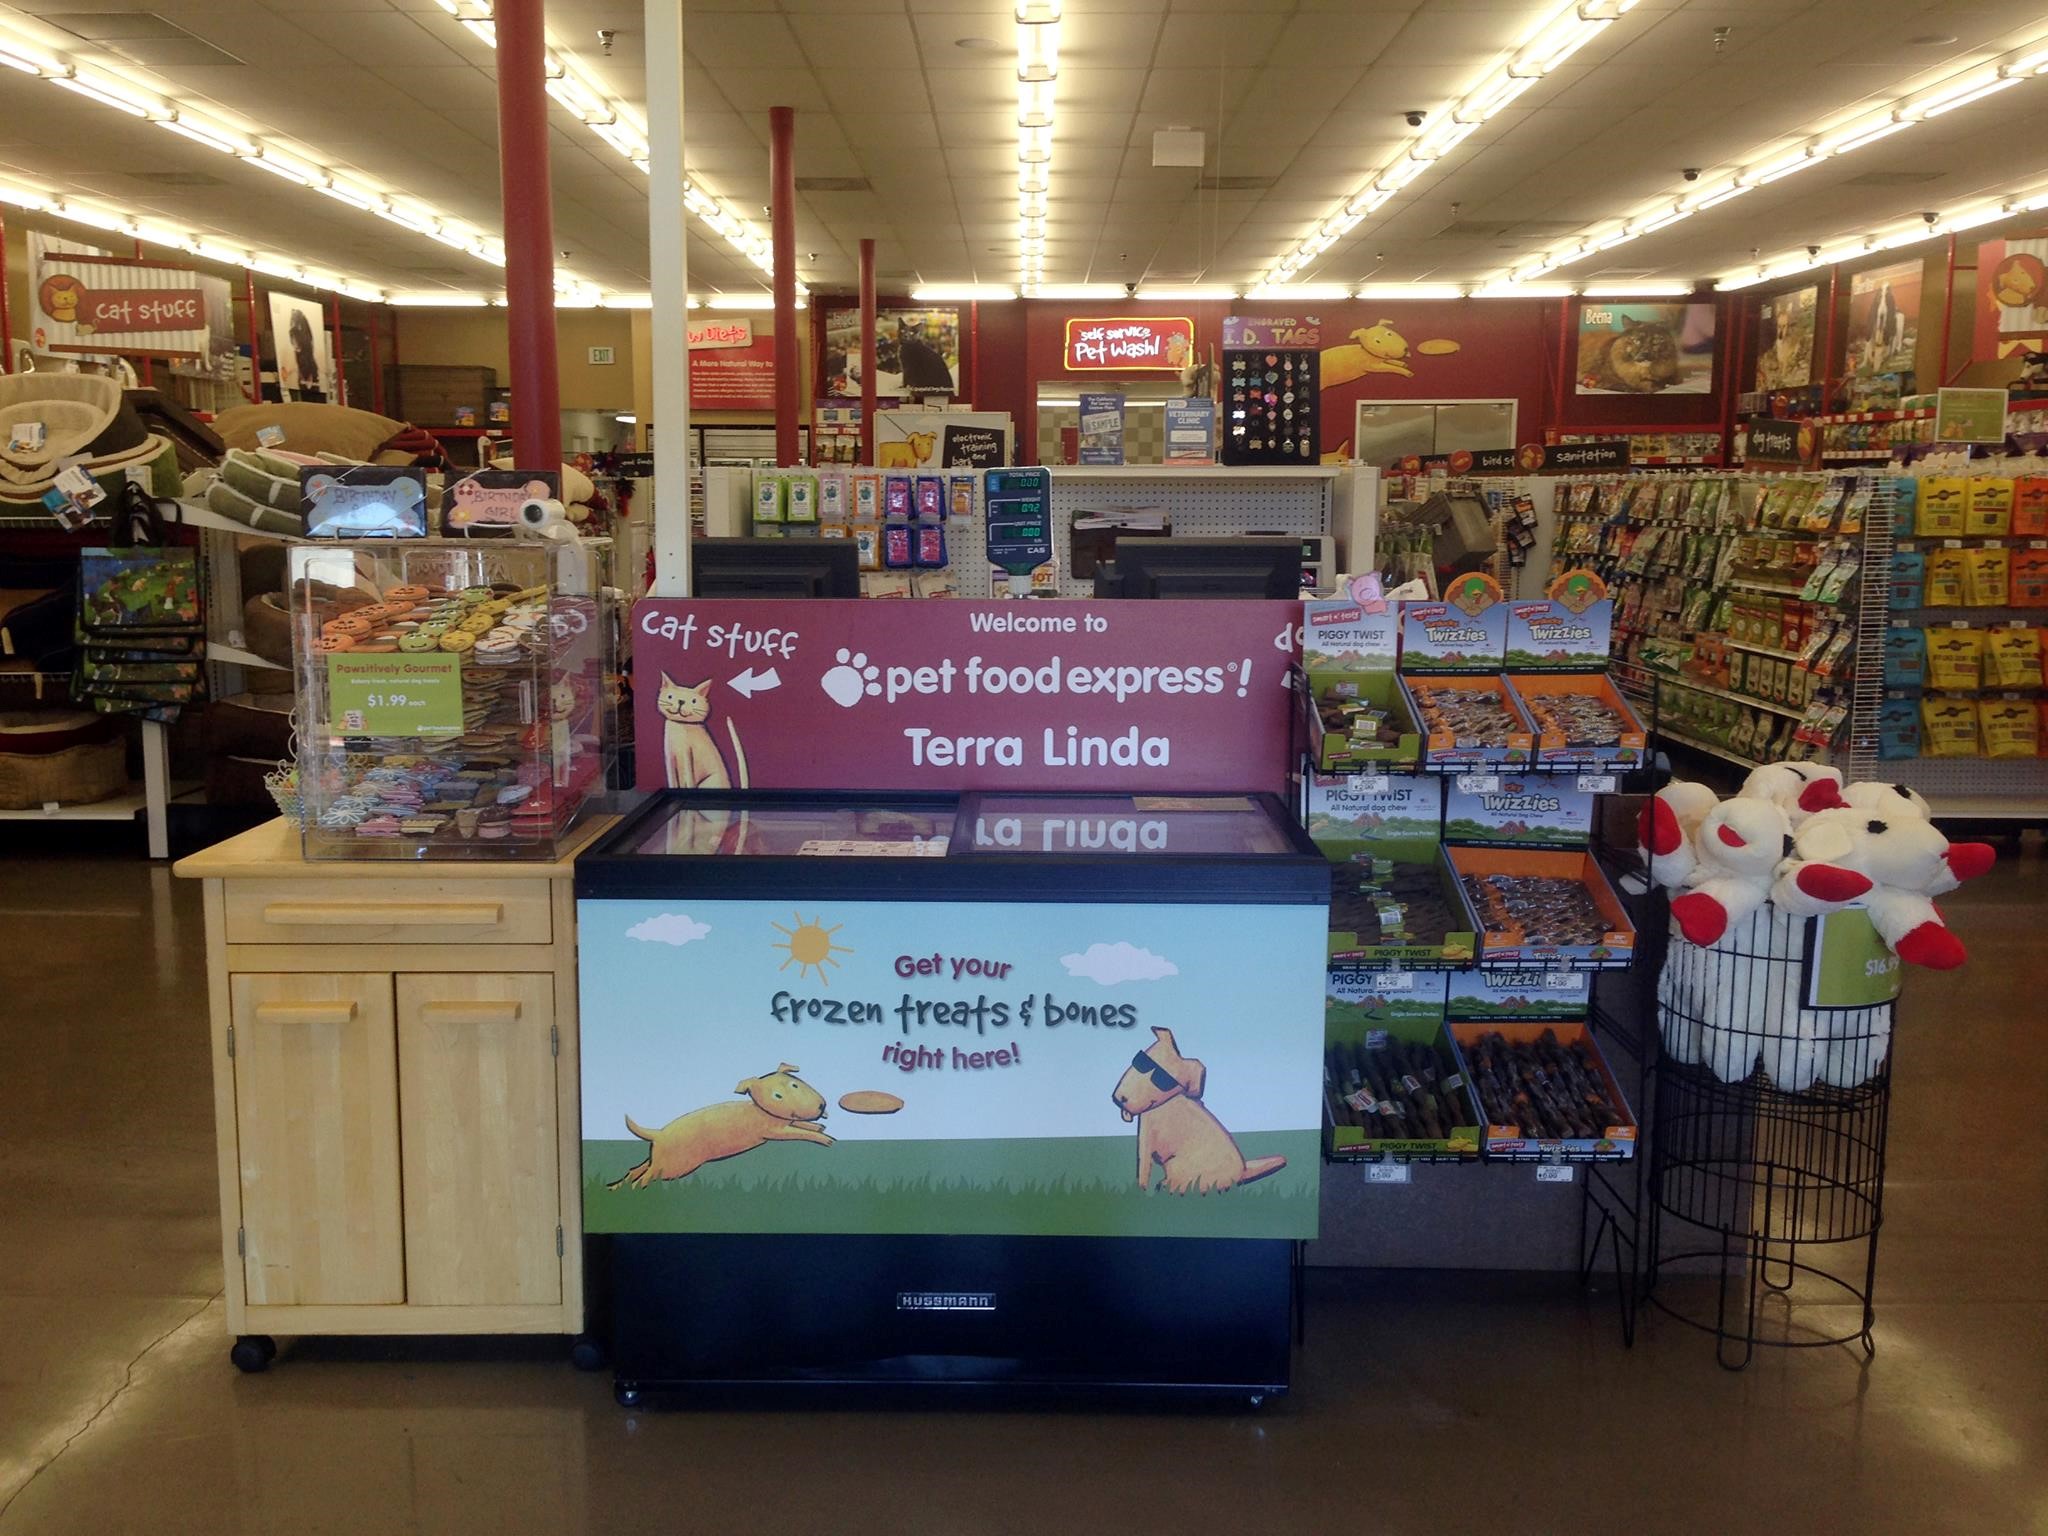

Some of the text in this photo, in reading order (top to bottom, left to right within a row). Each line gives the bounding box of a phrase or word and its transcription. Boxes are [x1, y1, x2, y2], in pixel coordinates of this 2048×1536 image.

[139, 299, 196, 324] stuff
[1585, 308, 1612, 325] Beena
[1247, 318, 1296, 326] ENGRAVED
[1080, 326, 1151, 341] self service
[1271, 328, 1320, 345] TAGS
[1074, 343, 1107, 364] Pet
[960, 442, 997, 455] training
[1556, 448, 1617, 463] sanitation
[972, 453, 986, 461] and
[1482, 455, 1502, 467] bird
[334, 490, 397, 504] BIRTHDAY
[970, 612, 1108, 632] Welcome to
[706, 622, 799, 660] stuff
[1318, 630, 1385, 639] PIGGY TWIST
[336, 664, 453, 675] Pawsitively Gourmet
[887, 658, 957, 703] pet
[964, 656, 1060, 694] food
[368, 693, 407, 707] $1.99
[904, 726, 1170, 767] Terra Linda
[1371, 804, 1385, 814] dog
[1374, 949, 1431, 957] PIGGY TWIST
[894, 953, 1012, 980] Get your
[1332, 974, 1372, 985] PIGGY
[771, 991, 1136, 1034] frozen treats & bones
[882, 1041, 1020, 1072] right here!
[903, 1296, 988, 1306] HUSSMANN
